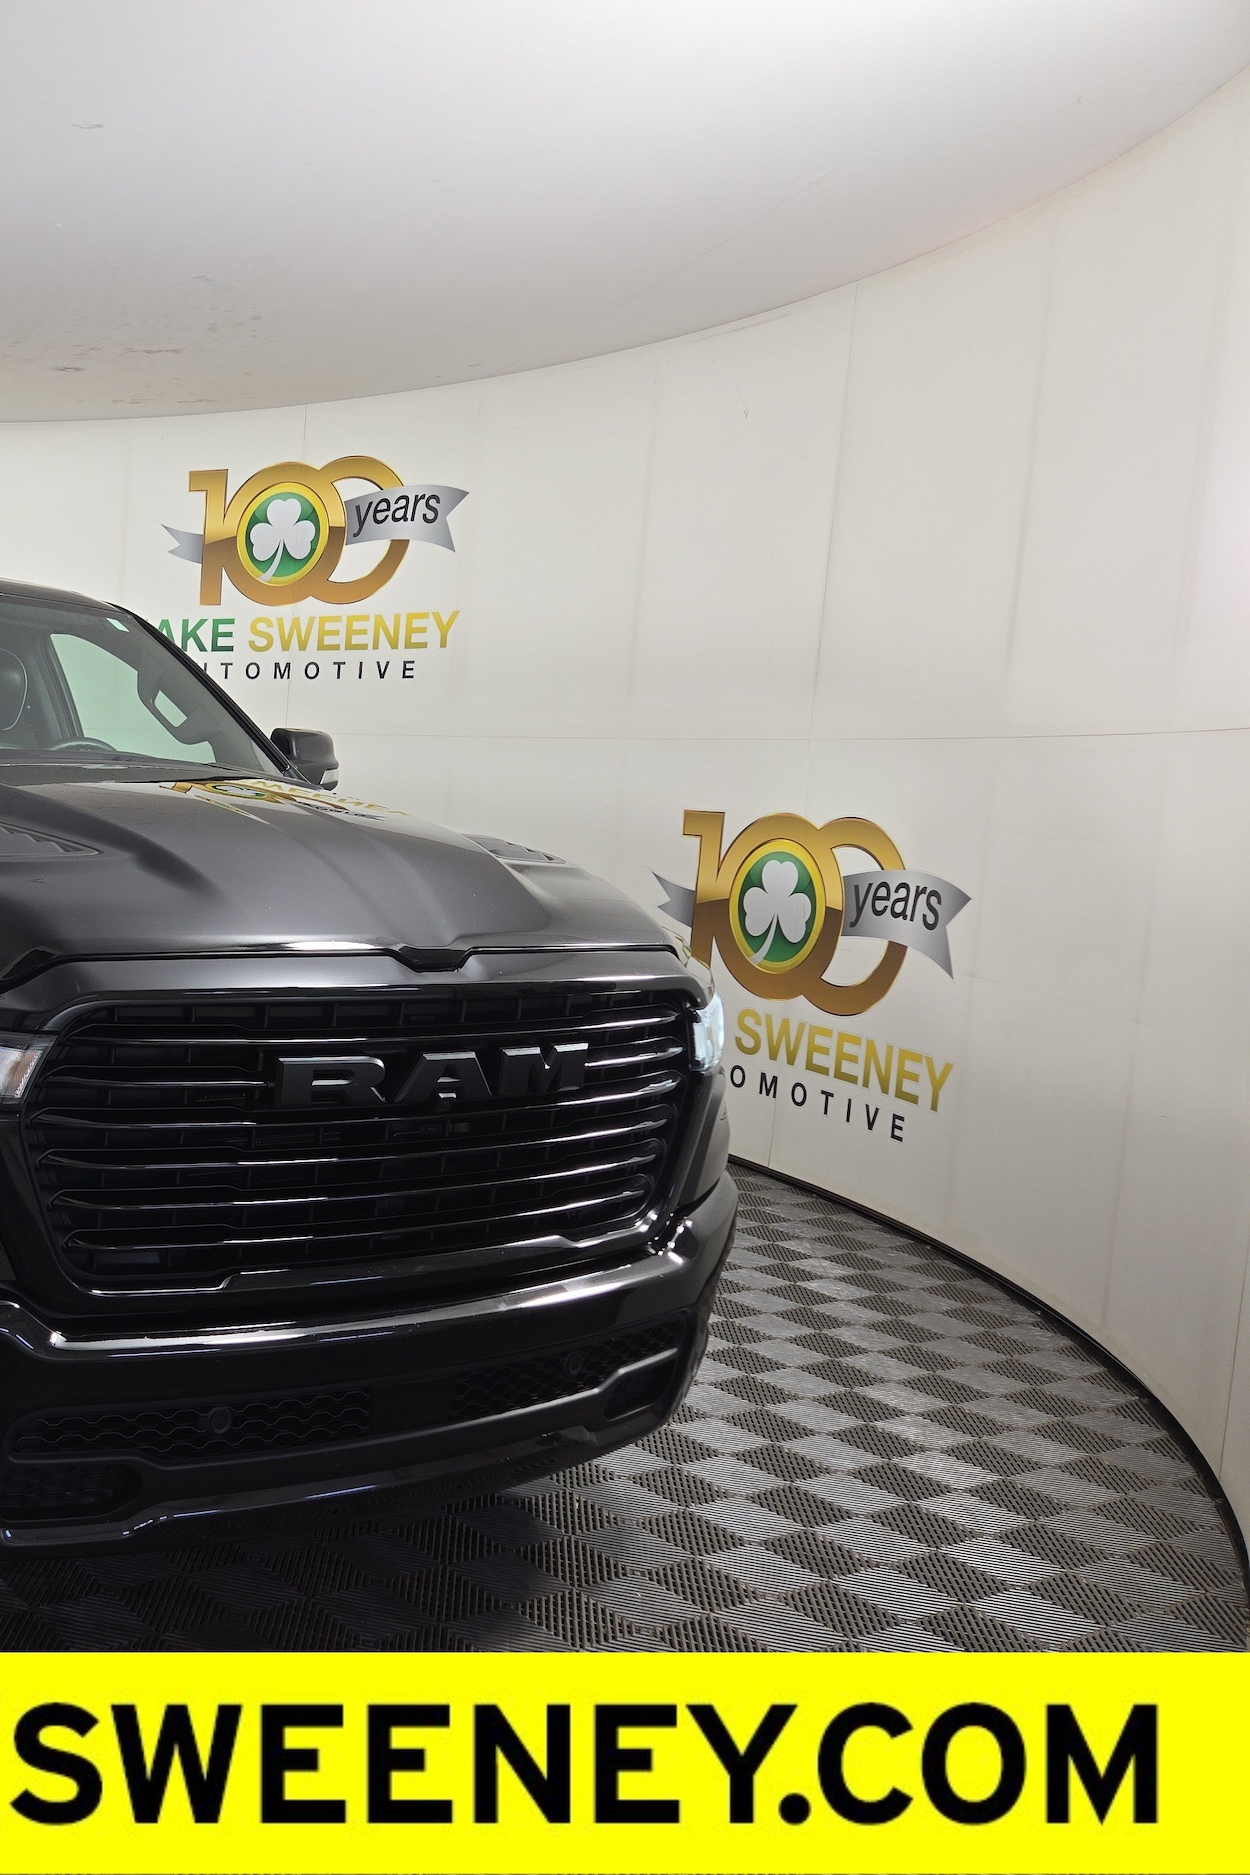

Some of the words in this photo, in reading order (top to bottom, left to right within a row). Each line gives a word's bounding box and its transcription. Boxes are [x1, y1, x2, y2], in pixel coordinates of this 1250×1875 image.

[352, 491, 441, 538] years
[148, 617, 236, 653] AKE
[248, 610, 461, 653] SWEENEY
[202, 660, 416, 680] TOMOTIVE
[849, 880, 942, 931] years
[275, 1042, 589, 1107] RAM
[734, 1008, 954, 1113] SWEENEY
[729, 1064, 906, 1142] OMOTIVE
